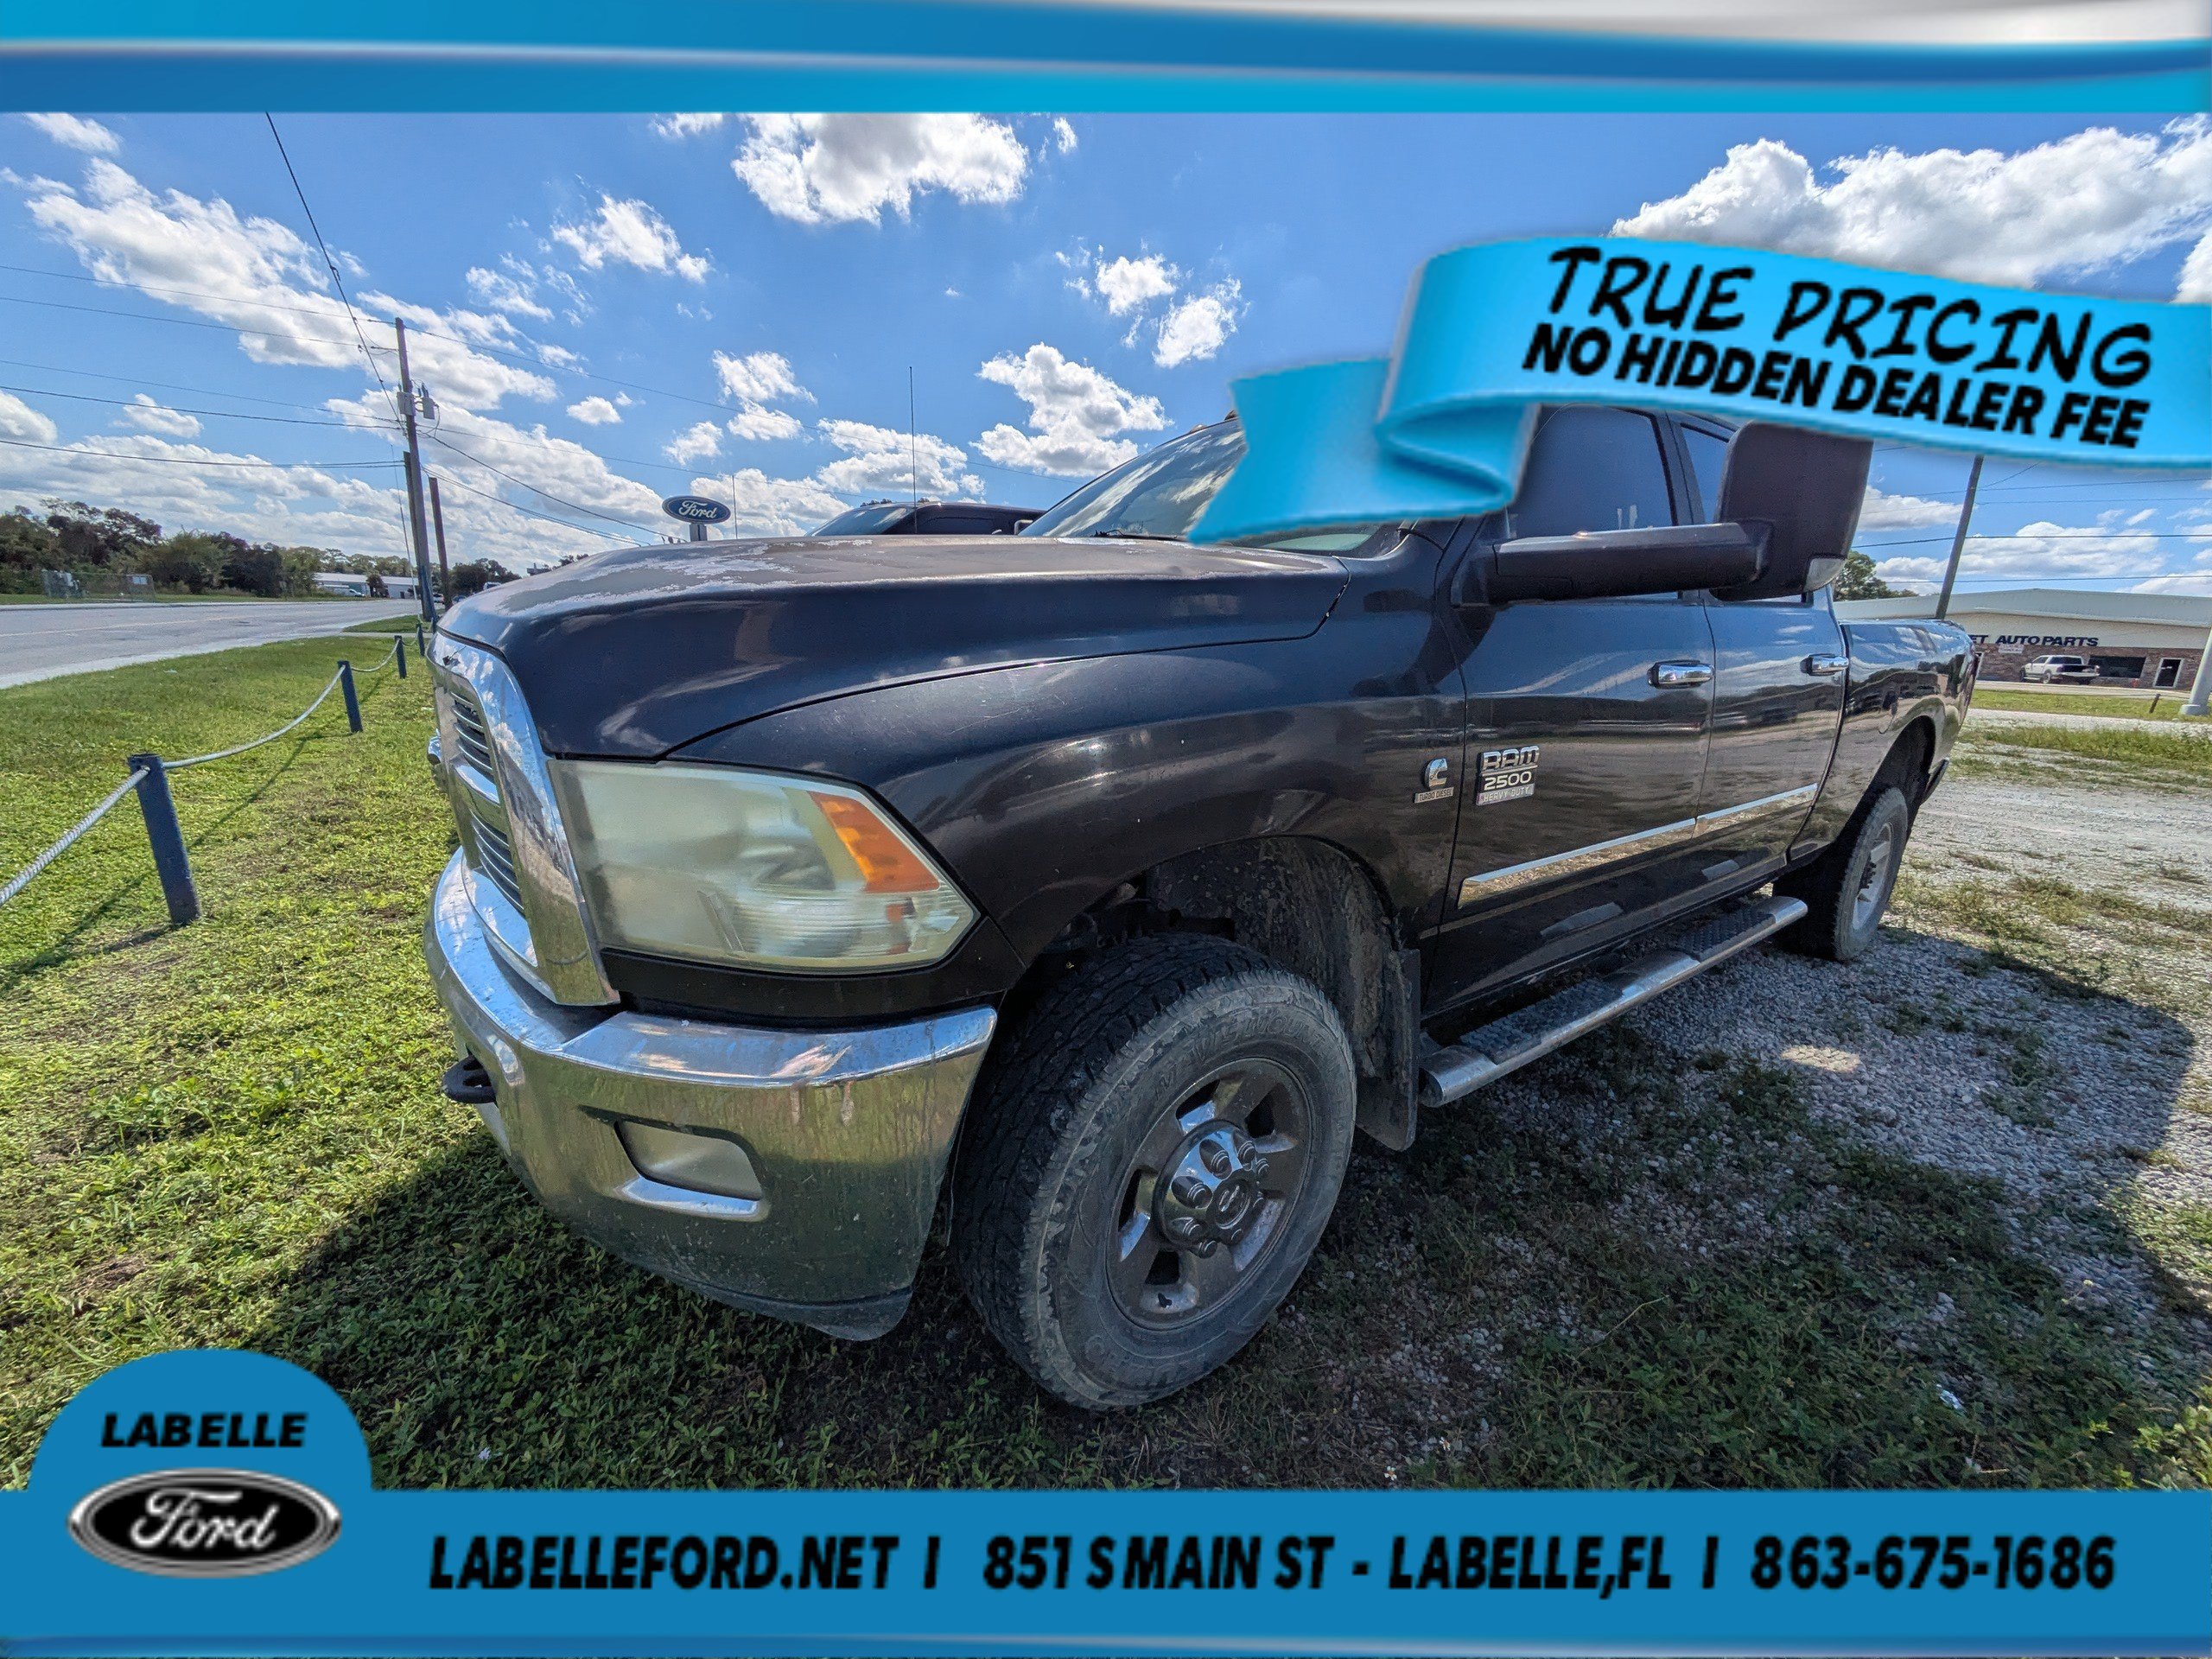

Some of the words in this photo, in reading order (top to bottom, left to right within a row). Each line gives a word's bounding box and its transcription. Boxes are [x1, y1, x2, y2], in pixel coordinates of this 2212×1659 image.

[678, 500, 717, 518] Ford
[1995, 634, 2041, 645] AUTO
[2041, 636, 2100, 647] PARTS
[1482, 745, 1540, 771] RAM
[1484, 771, 1532, 791] 2500
[1419, 791, 1435, 802] TURBO
[1435, 788, 1452, 798] DIESEL
[1484, 791, 1509, 803] HEAVY
[1511, 786, 1530, 798] DUTY
